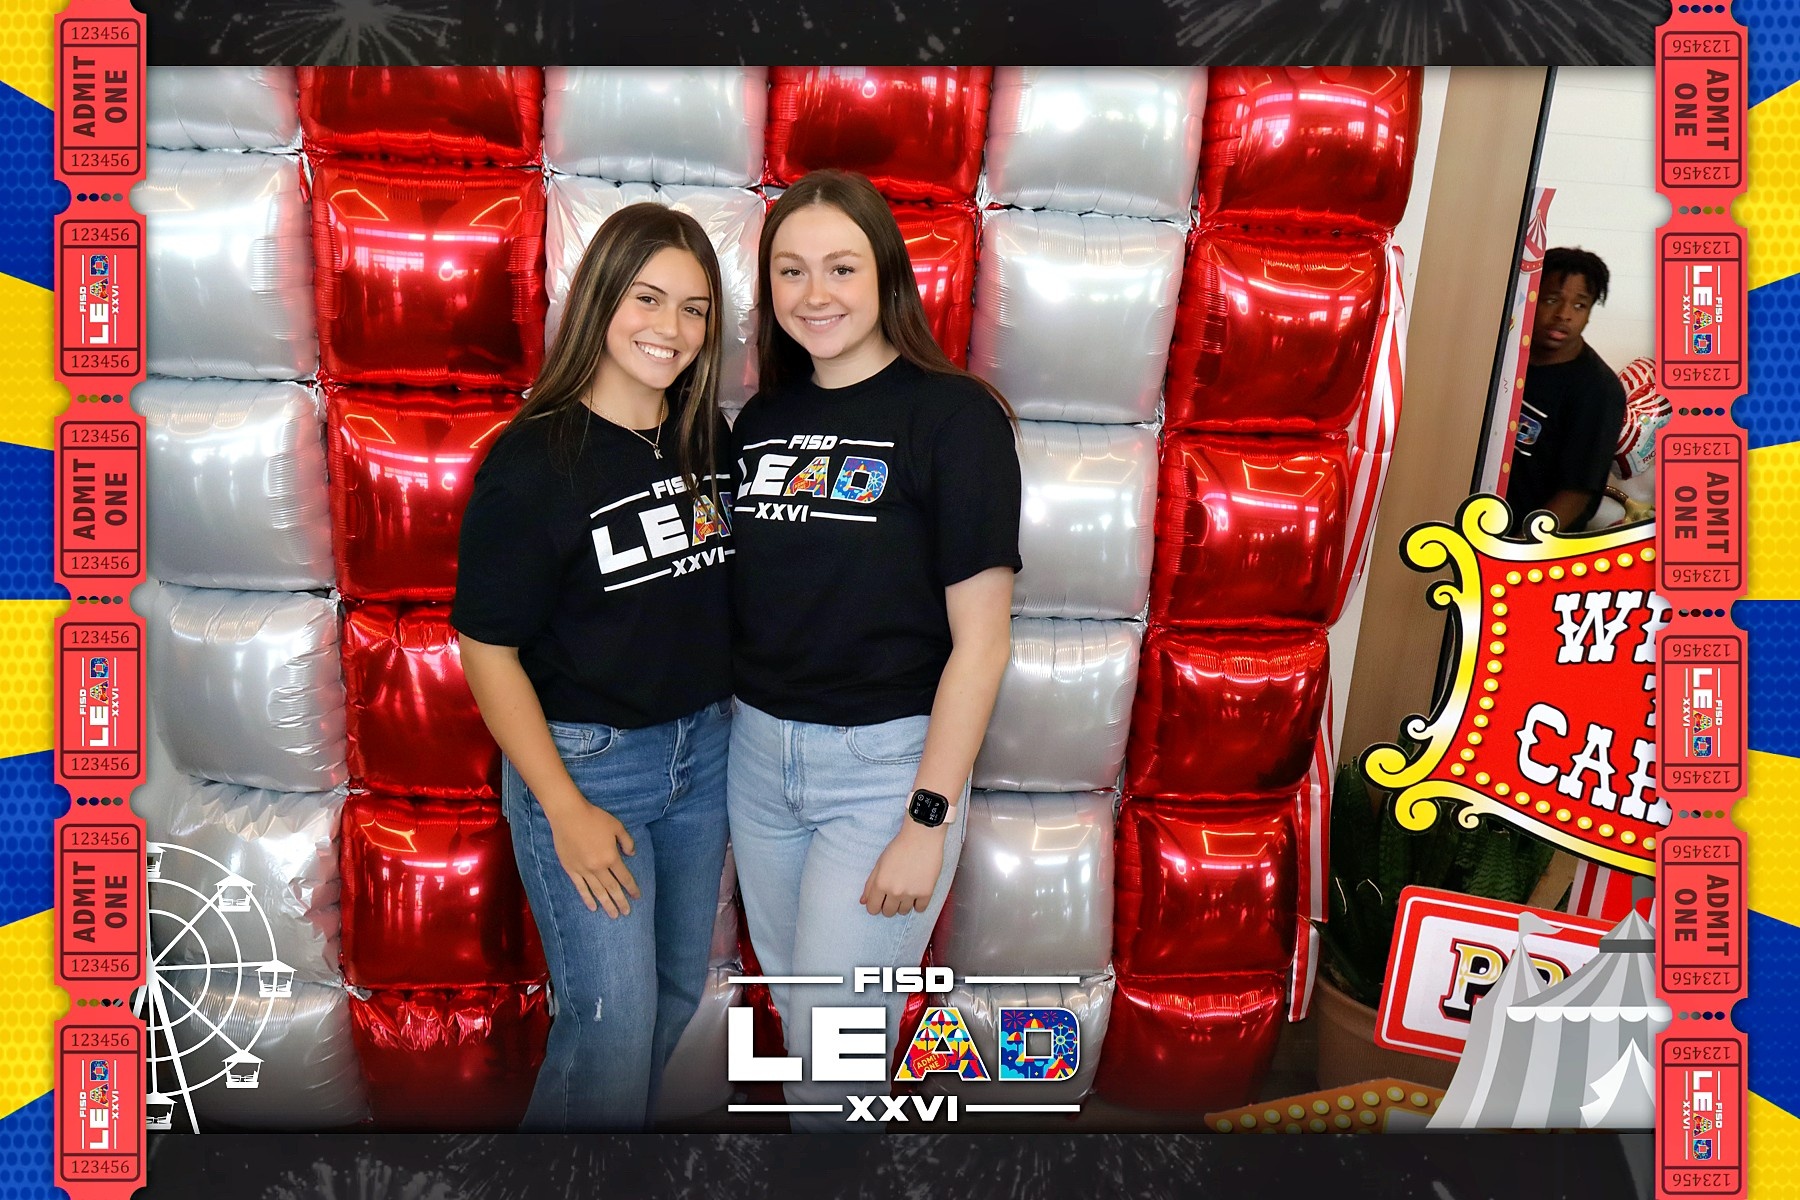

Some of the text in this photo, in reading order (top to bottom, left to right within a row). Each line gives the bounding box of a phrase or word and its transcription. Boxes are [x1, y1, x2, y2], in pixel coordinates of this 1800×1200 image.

[788, 434, 838, 450] FISD
[737, 453, 889, 504] LEAD
[754, 502, 809, 523] XXVI
[672, 546, 725, 577] XXVI
